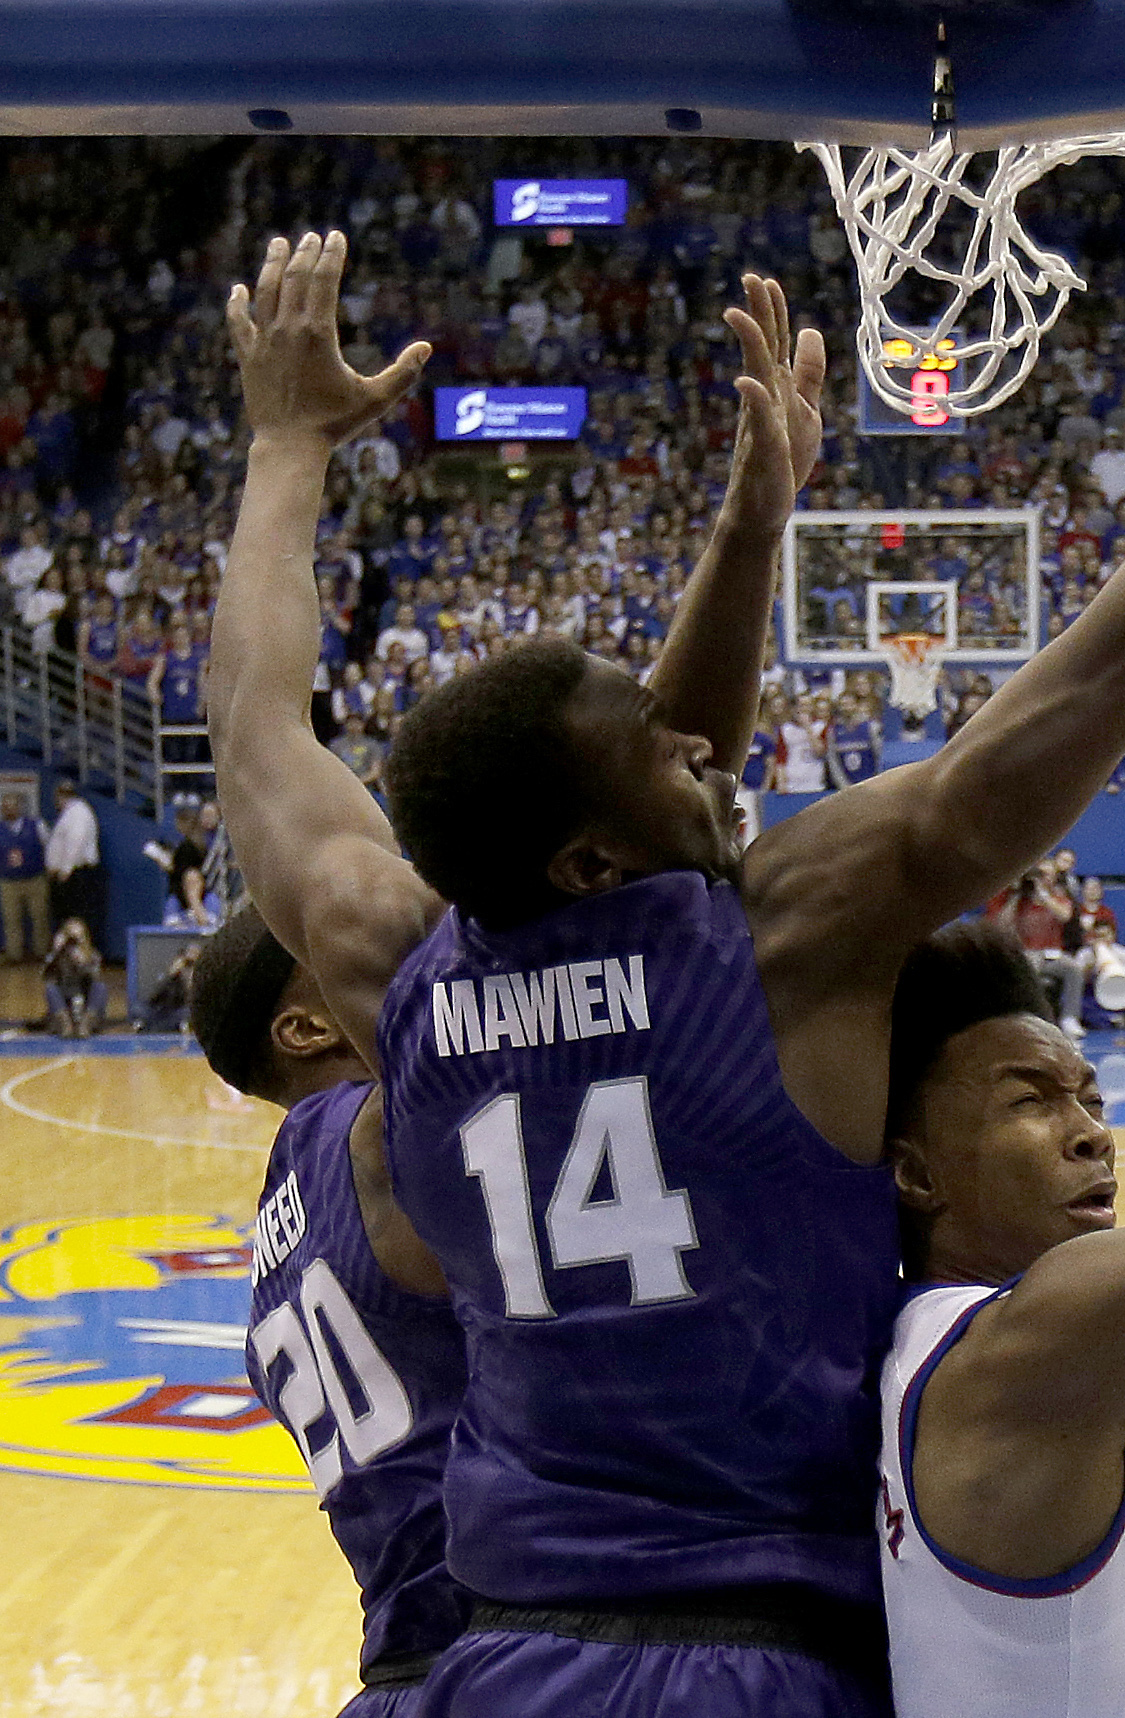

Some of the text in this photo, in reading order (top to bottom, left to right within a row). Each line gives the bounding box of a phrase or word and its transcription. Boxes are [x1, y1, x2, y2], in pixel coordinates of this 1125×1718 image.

[432, 954, 651, 1057] MAWIEN
[458, 1075, 701, 1320] 14
[250, 1257, 414, 1501] 20
